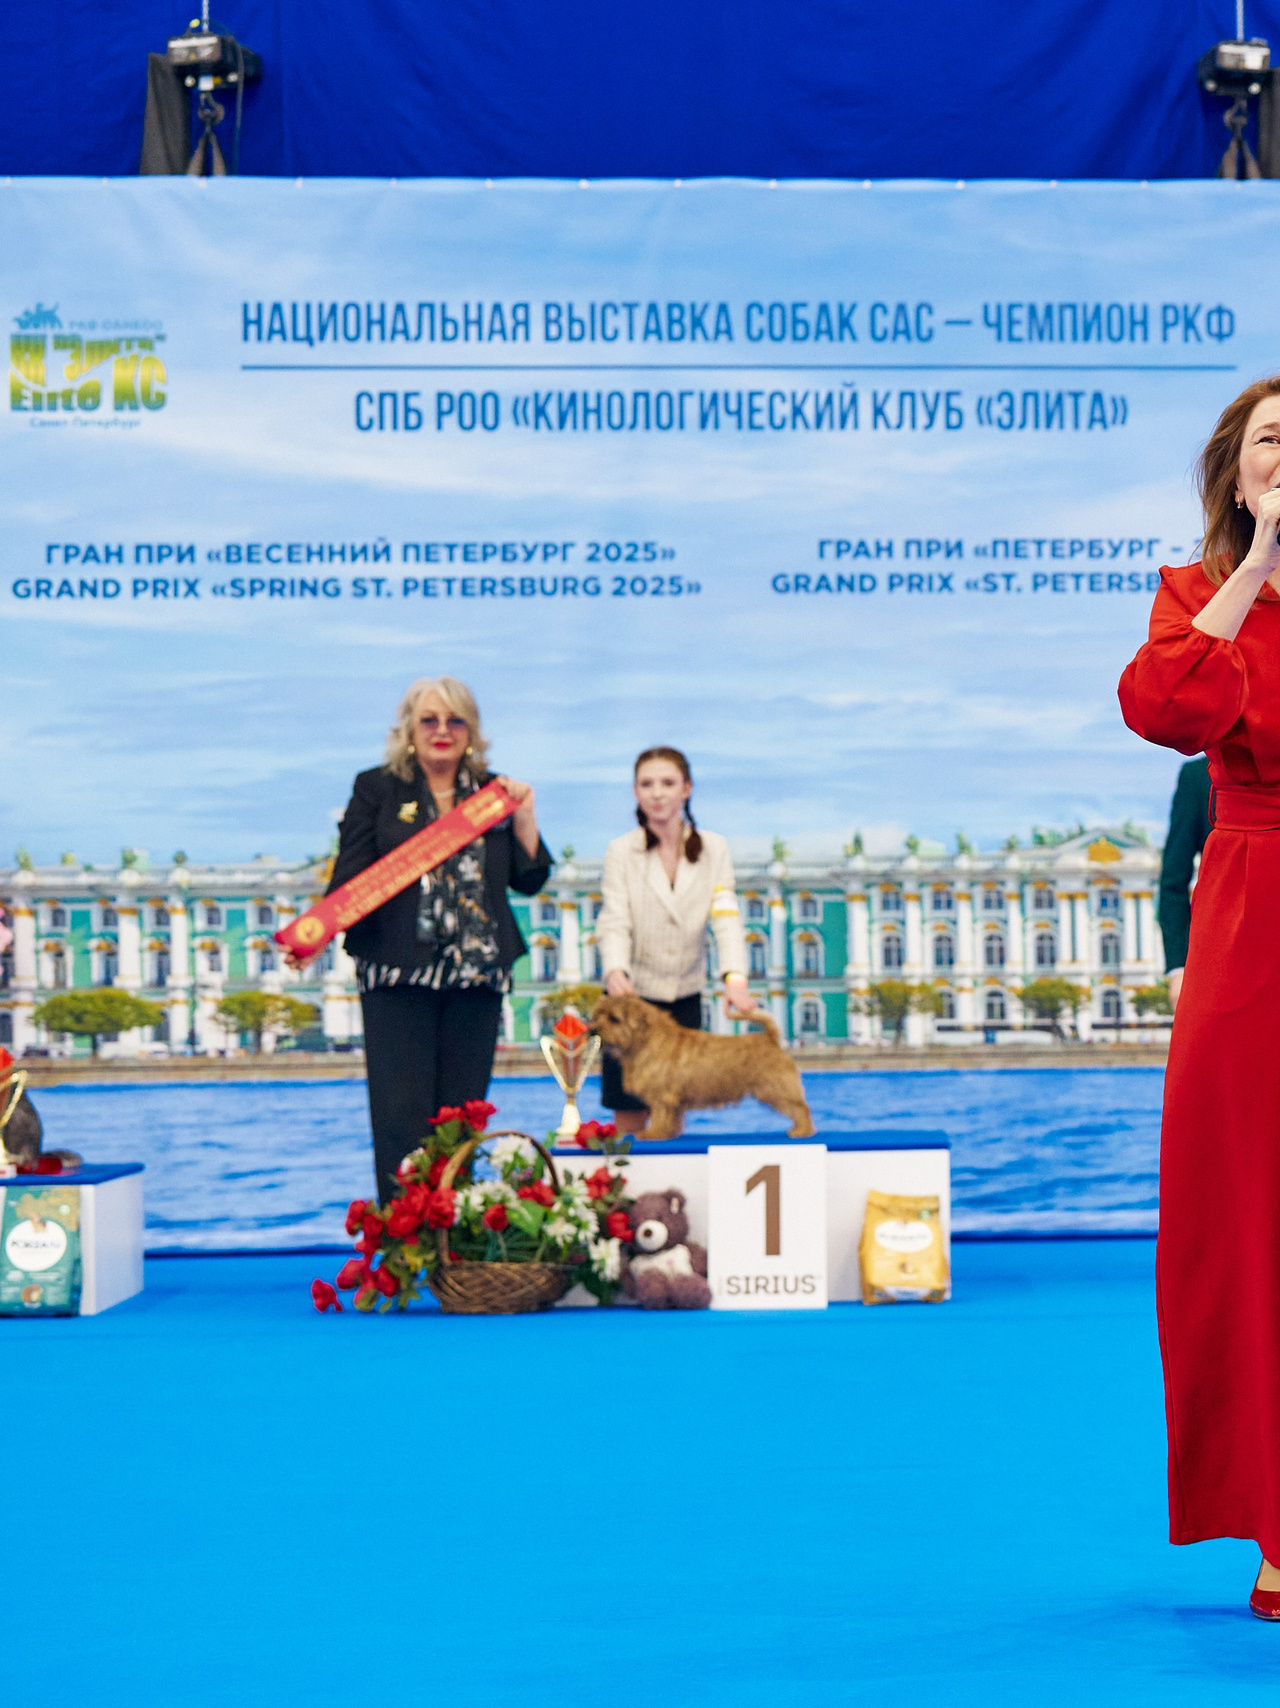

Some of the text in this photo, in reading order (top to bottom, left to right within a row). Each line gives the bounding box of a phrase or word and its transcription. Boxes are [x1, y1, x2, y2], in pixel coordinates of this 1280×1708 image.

[242, 301, 531, 348] НАЦИОНАЛЬНАЯ
[543, 301, 734, 343] ВЫСТАВКА
[745, 301, 858, 343] СОБАК
[982, 302, 1149, 344] ЧЕМПИОН
[1161, 302, 1235, 344] РКФ
[354, 382, 1129, 434] СПБ РОО «КИНОЛОГИЧЕСКИЙ КЛУБ «ЭЛИТА»
[46, 537, 676, 565] ГРАН ПРИ «ВЕСЕННИЙ ПЕТЕРБУРГ 2025»
[818, 538, 894, 560] ГРАН
[903, 538, 964, 560] ПРИ
[973, 538, 1161, 560] «ПЕТЕРБУРГ
[11, 575, 702, 600] GRAND PRIX «SPRING ST. PETERSBURG 2025»
[771, 572, 1160, 595] GRAND PRIX «ST. PETERSB
[745, 1164, 781, 1256] 1
[726, 1273, 817, 1296] SIRIUS
